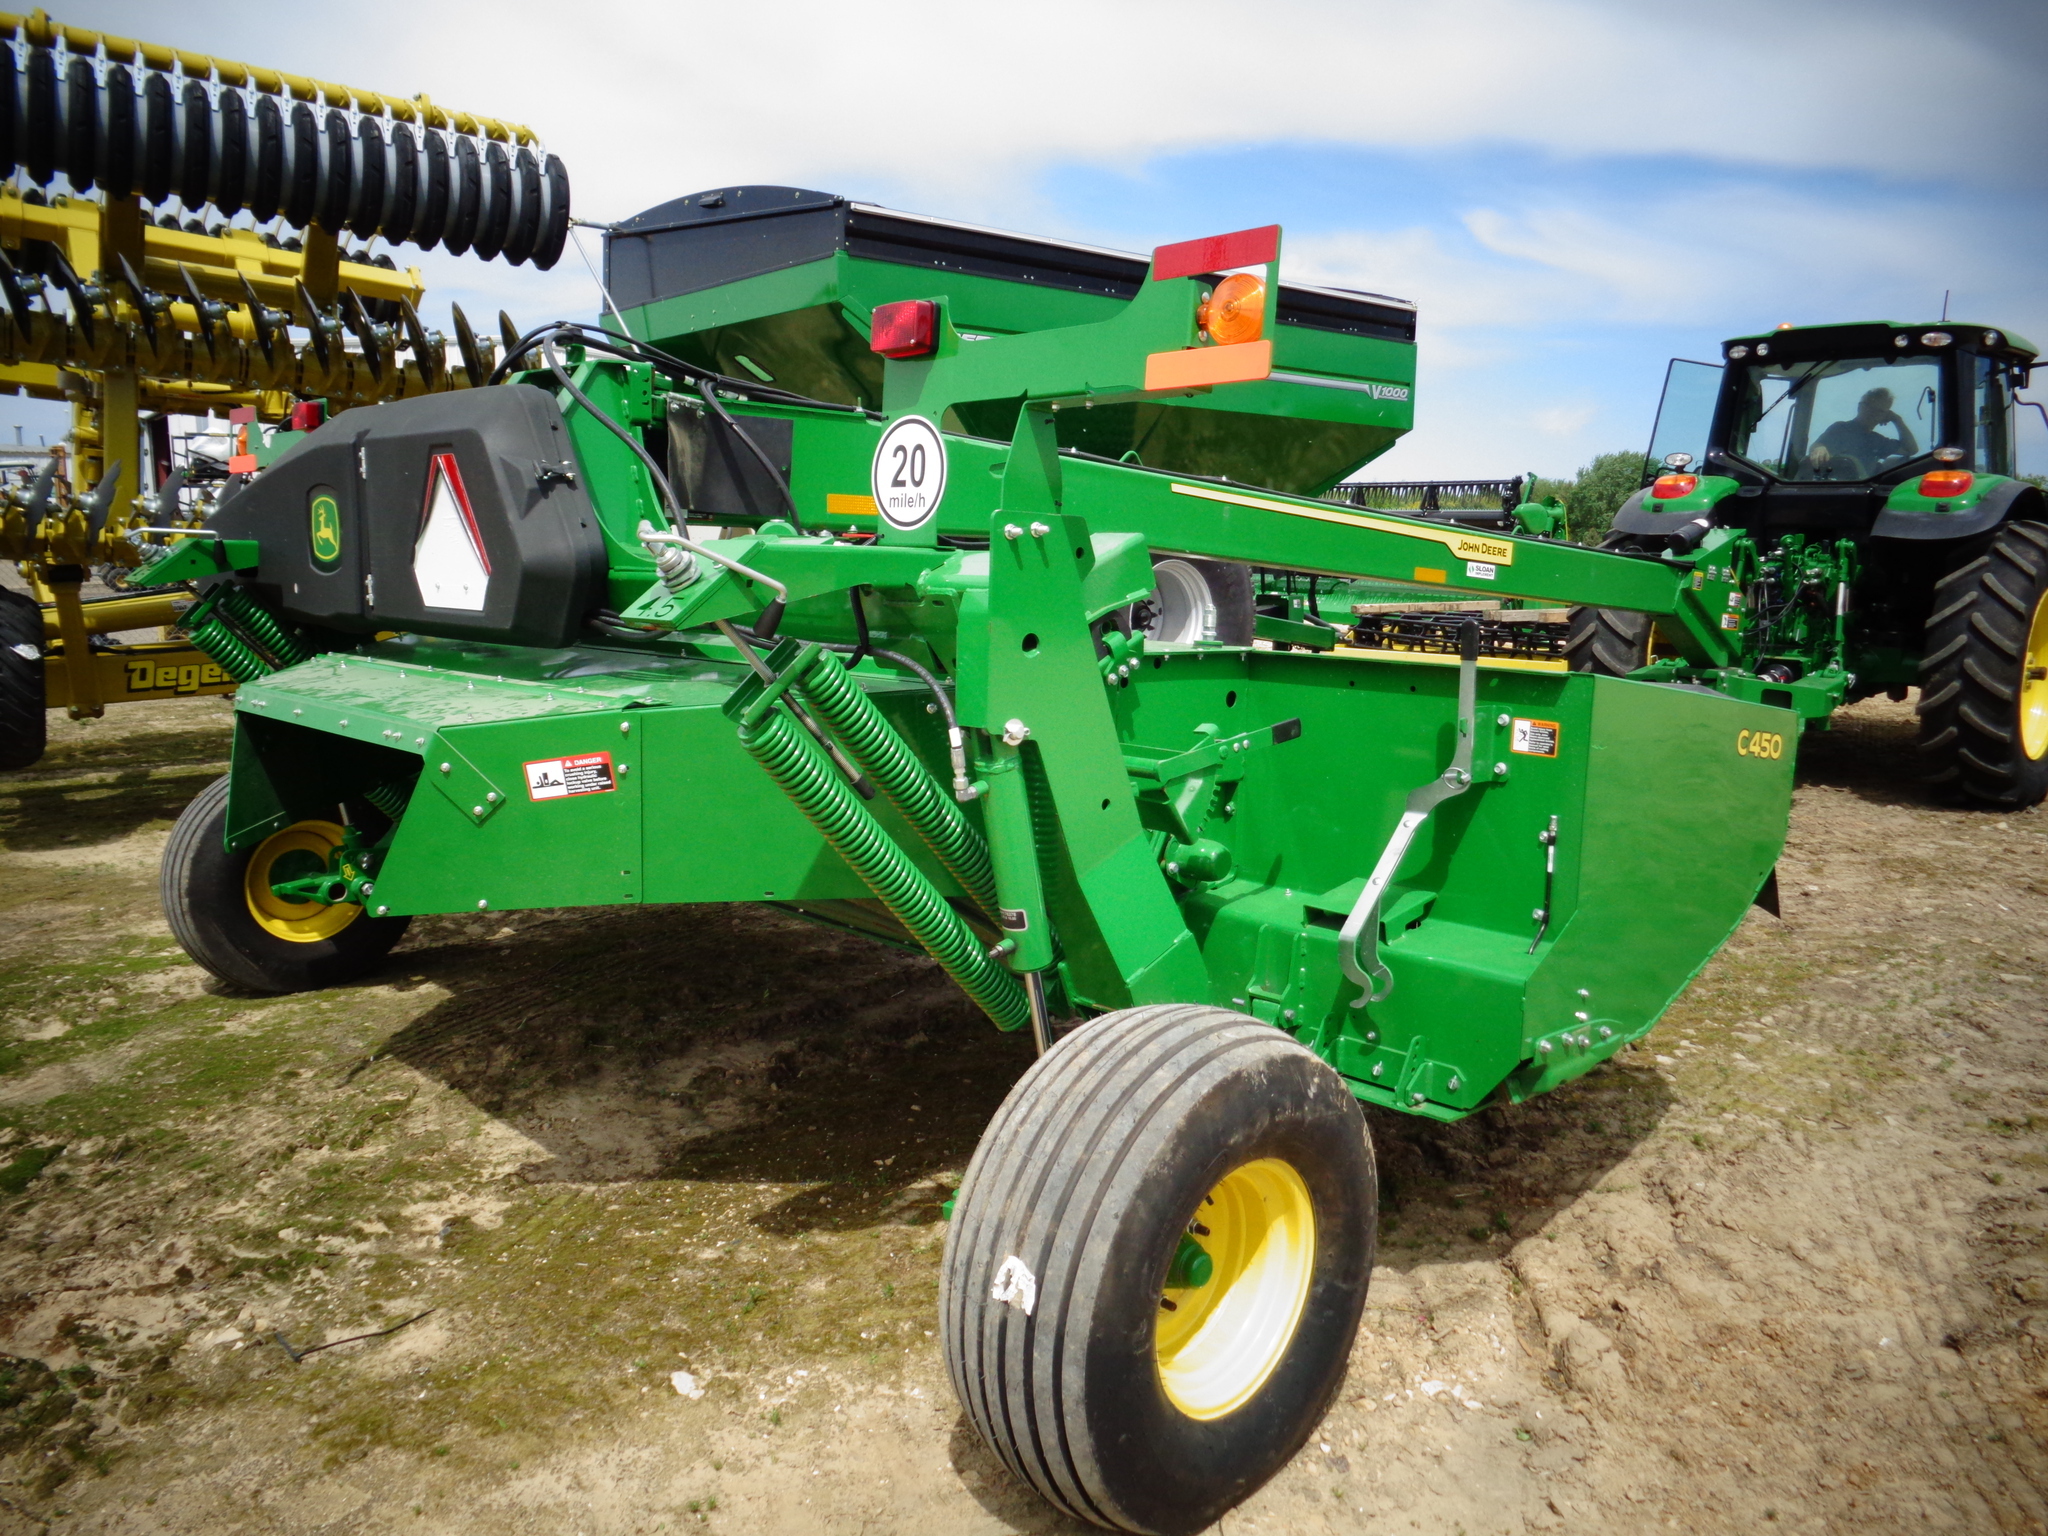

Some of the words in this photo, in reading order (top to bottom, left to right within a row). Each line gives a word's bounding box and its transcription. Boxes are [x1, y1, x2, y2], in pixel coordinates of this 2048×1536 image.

[1372, 384, 1408, 399] V1000
[891, 444, 926, 488] 20
[889, 493, 926, 508] mile/h
[1458, 540, 1480, 553] JOHN
[1481, 543, 1507, 557] DEERE
[1475, 565, 1494, 573] SLOAN
[636, 596, 684, 618] 4.5
[1737, 728, 1782, 760] C450
[574, 757, 602, 766] DANGER
